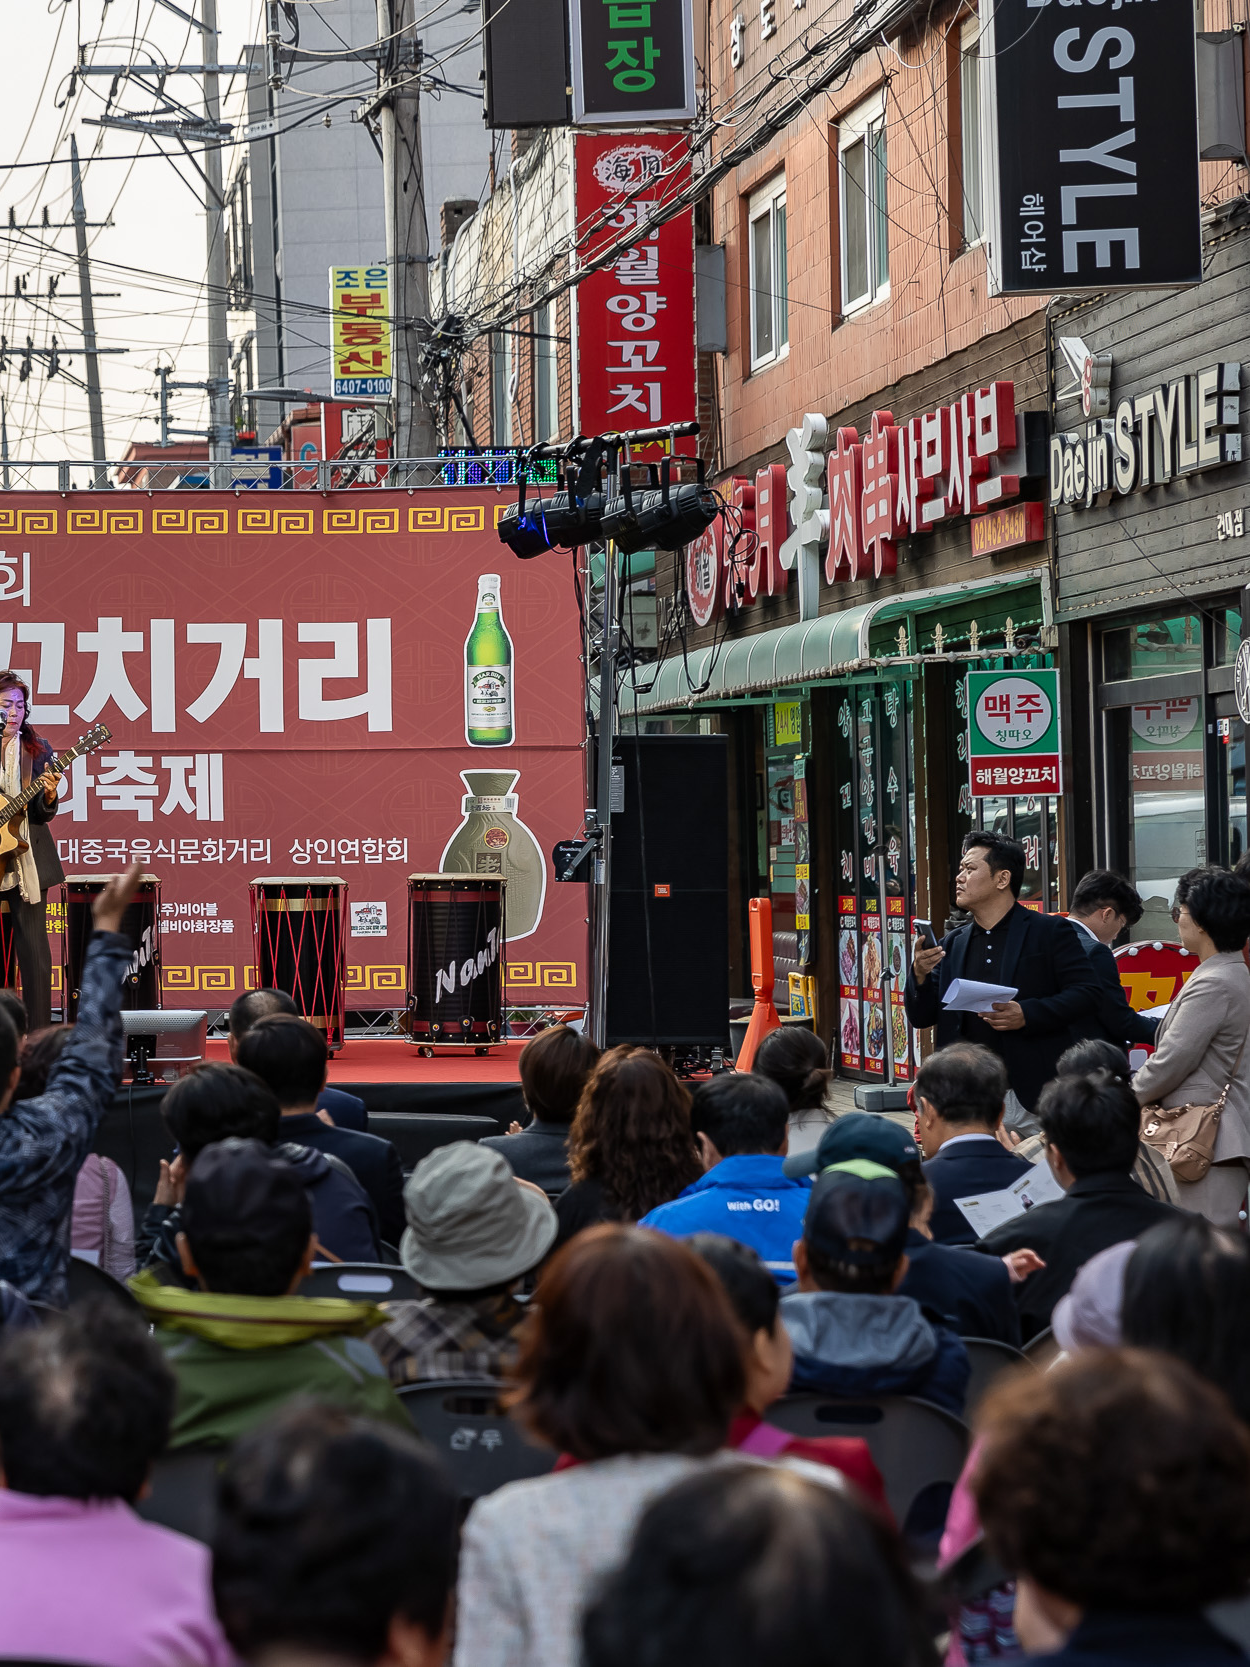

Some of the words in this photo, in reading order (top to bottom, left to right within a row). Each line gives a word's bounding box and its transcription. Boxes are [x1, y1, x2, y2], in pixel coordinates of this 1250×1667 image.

[1053, 26, 1140, 273] STYLE
[1019, 193, 1048, 273] 헤어샵
[335, 379, 391, 394] 6407-0100
[1049, 422, 1110, 508] Daejin
[1115, 363, 1222, 495] STYLE
[974, 511, 1026, 551] 02)462-5450
[984, 693, 1044, 724] 맥주
[995, 728, 1034, 742] 칭따오
[862, 698, 876, 882] 고급양갈비
[975, 766, 1057, 786] 해월양꼬치
[289, 837, 409, 864] 상인연합회
[156, 902, 218, 917] (주)비아블
[753, 1198, 781, 1213] GO!
